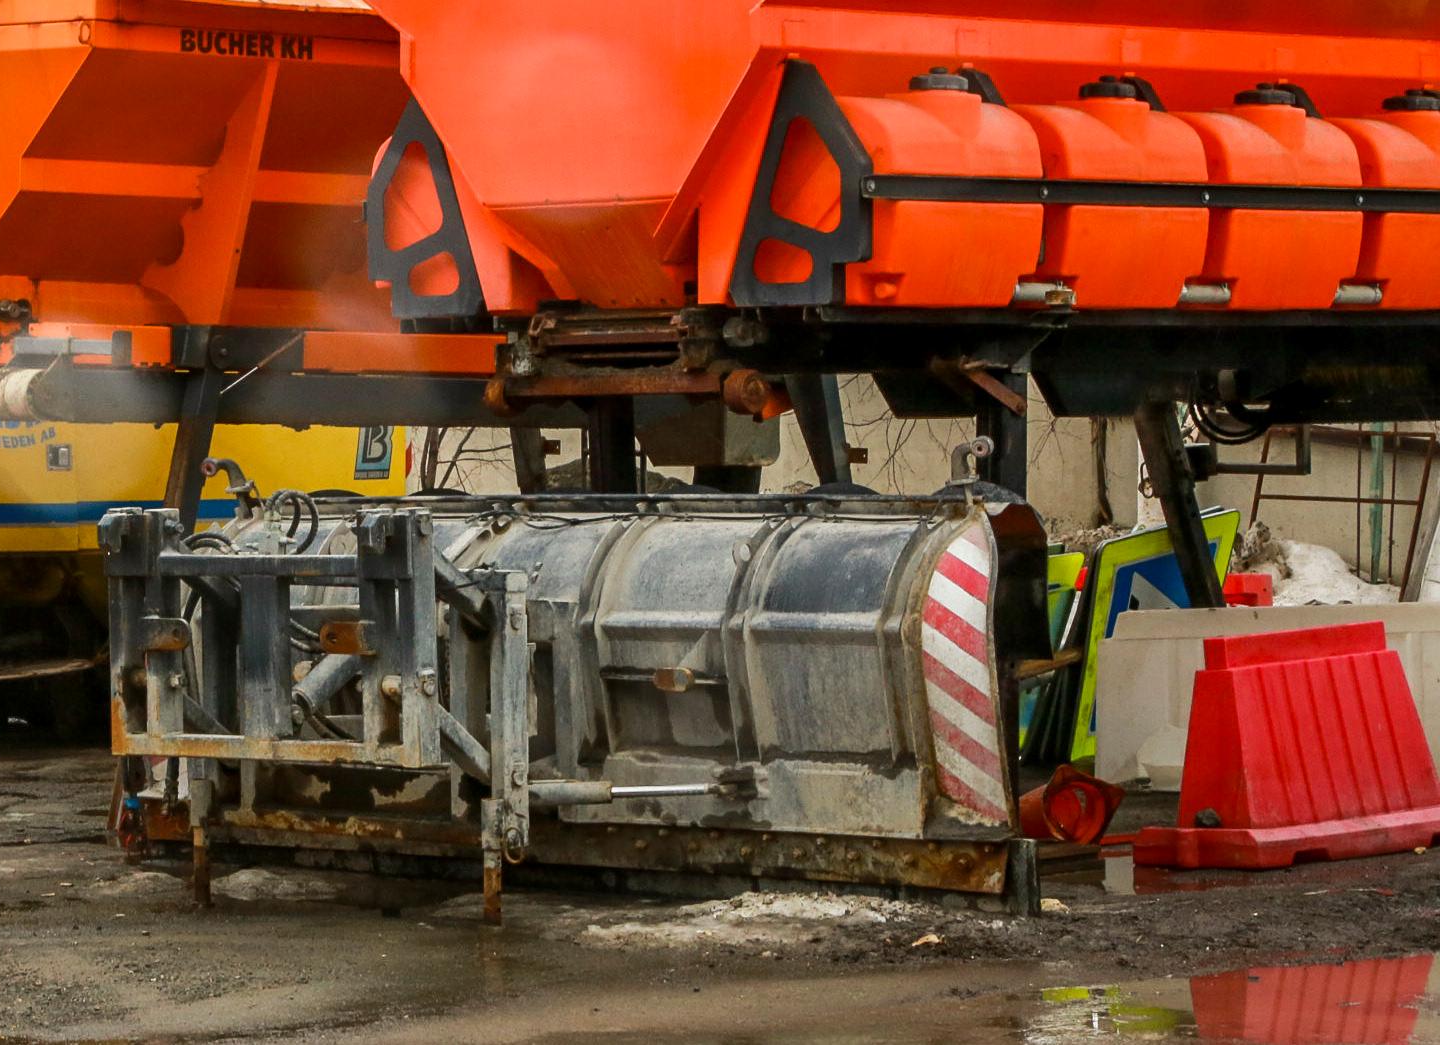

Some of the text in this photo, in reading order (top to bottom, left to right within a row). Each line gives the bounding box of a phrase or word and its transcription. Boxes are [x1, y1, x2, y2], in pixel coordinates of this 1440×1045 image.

[179, 28, 314, 60] BUCHER KH
[40, 426, 57, 443] AB
